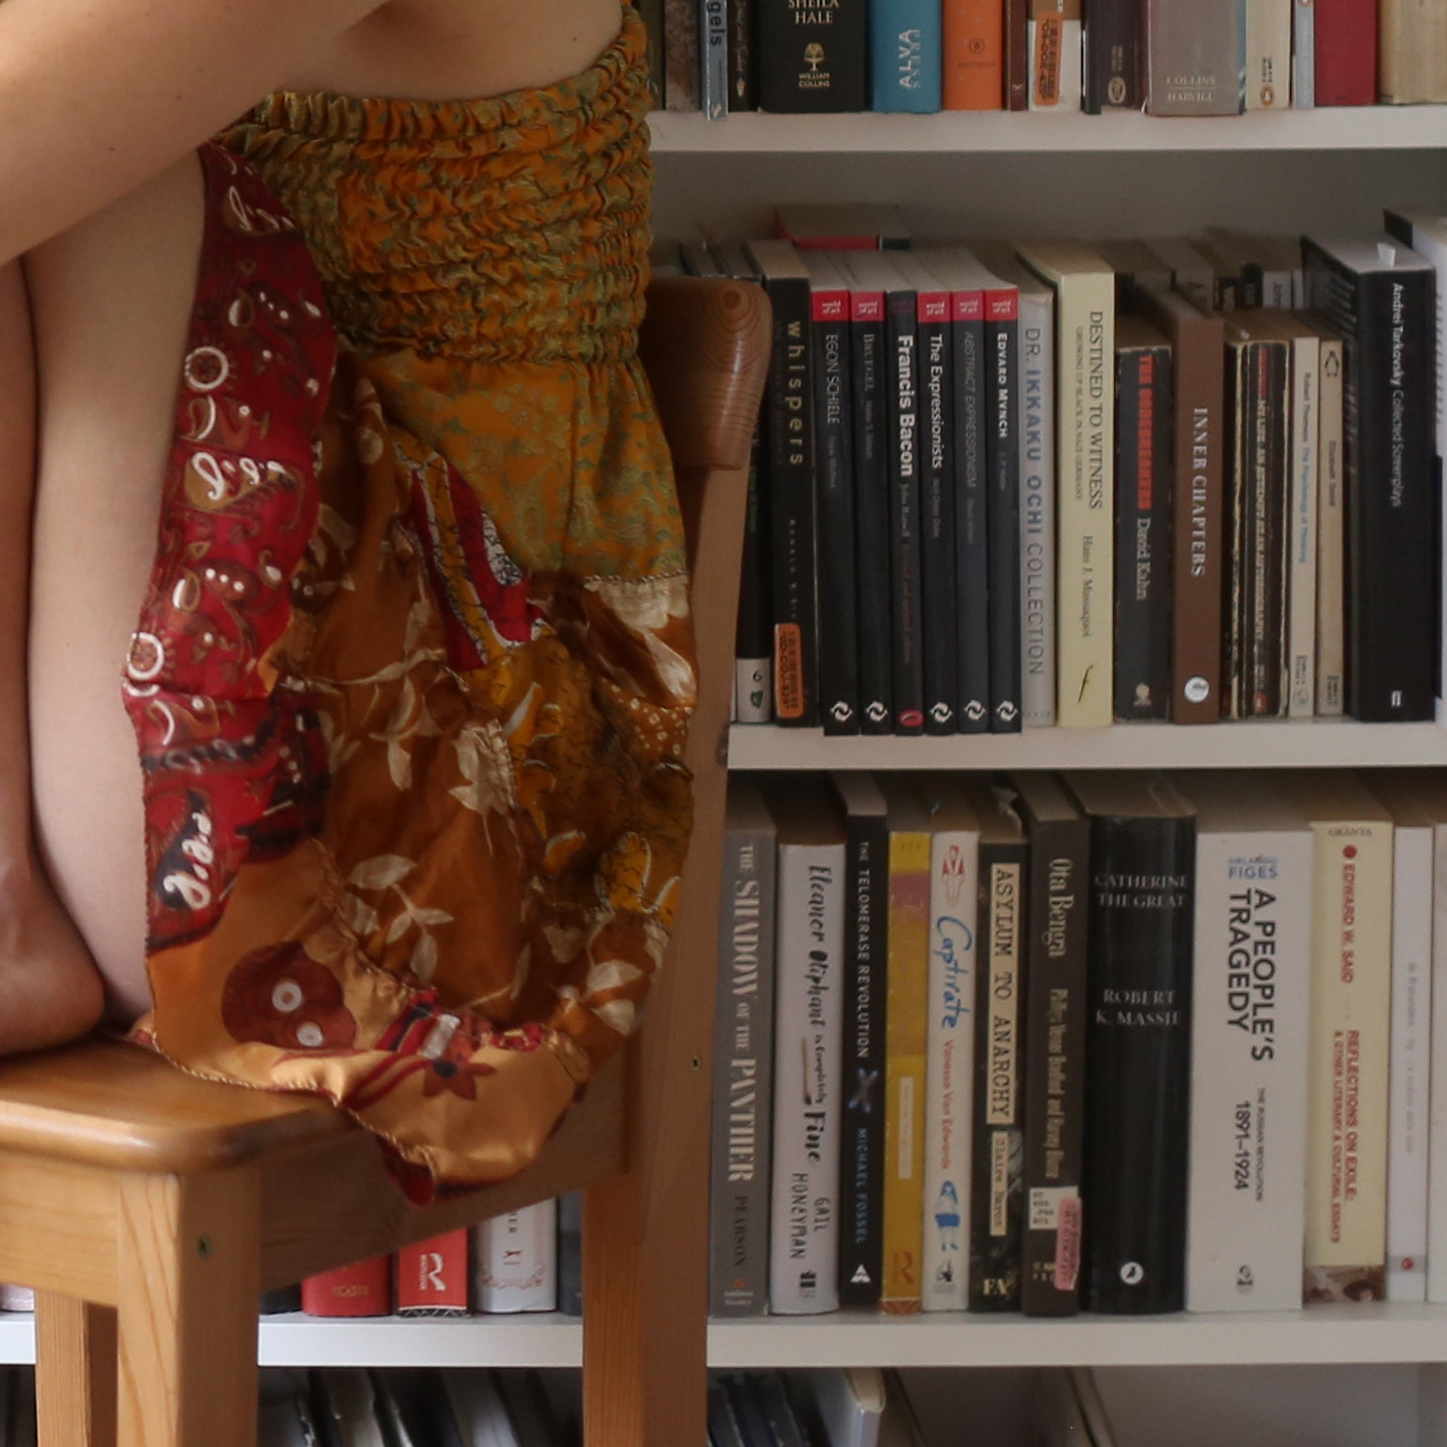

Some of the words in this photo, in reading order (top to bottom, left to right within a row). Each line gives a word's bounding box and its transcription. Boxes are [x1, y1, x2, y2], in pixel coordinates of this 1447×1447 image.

[795, 11, 833, 24] HALE
[898, 334, 914, 408] Francis
[930, 334, 943, 362] The
[1025, 328, 1041, 361] DR.
[1088, 311, 1104, 398] DESTINED
[786, 321, 804, 465] whispers
[928, 366, 945, 469] Expressionists
[1026, 369, 1042, 461] IKKAKU
[1089, 403, 1103, 427] TO
[899, 413, 915, 476] Bacon
[1088, 431, 1103, 509] WITNESS
[1027, 475, 1042, 535] OCHI
[1137, 517, 1151, 558] David
[1027, 543, 1044, 676] COLLECTION
[1136, 561, 1151, 600] Kahn
[739, 844, 753, 871] THE
[1049, 858, 1072, 890] Ota
[995, 868, 1015, 958] ASYLUM
[1044, 894, 1073, 958] Benga
[1253, 889, 1275, 909] A
[730, 879, 759, 1000] SHADOW
[1227, 888, 1251, 1032] TRAGEDY
[736, 1003, 751, 1020] OF
[996, 972, 1013, 999] TO
[1251, 920, 1276, 1061] PEOPLE'S
[736, 1023, 751, 1050] THE
[992, 1015, 1011, 1118] ANARCHY
[728, 1058, 756, 1181] PANTHER
